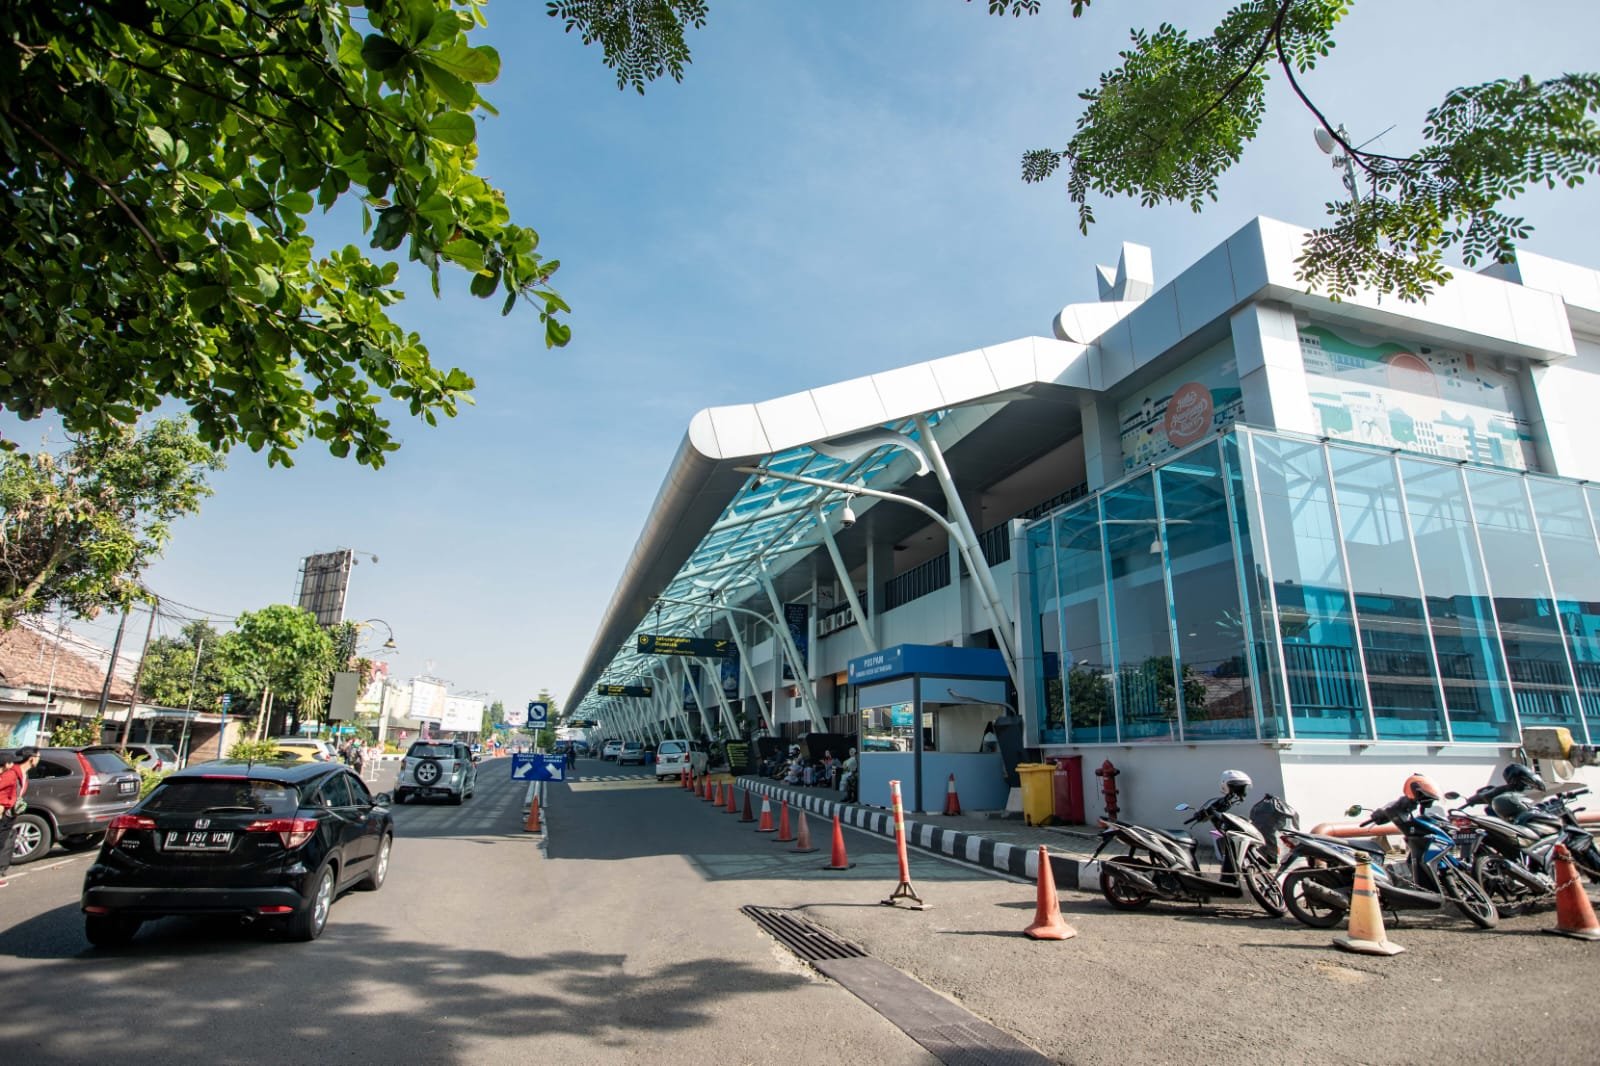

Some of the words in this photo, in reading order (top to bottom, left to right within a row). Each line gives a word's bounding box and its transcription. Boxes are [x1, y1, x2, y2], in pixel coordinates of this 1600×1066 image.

[170, 831, 178, 842] D
[185, 831, 208, 842] 1797
[212, 831, 231, 843] VCM
